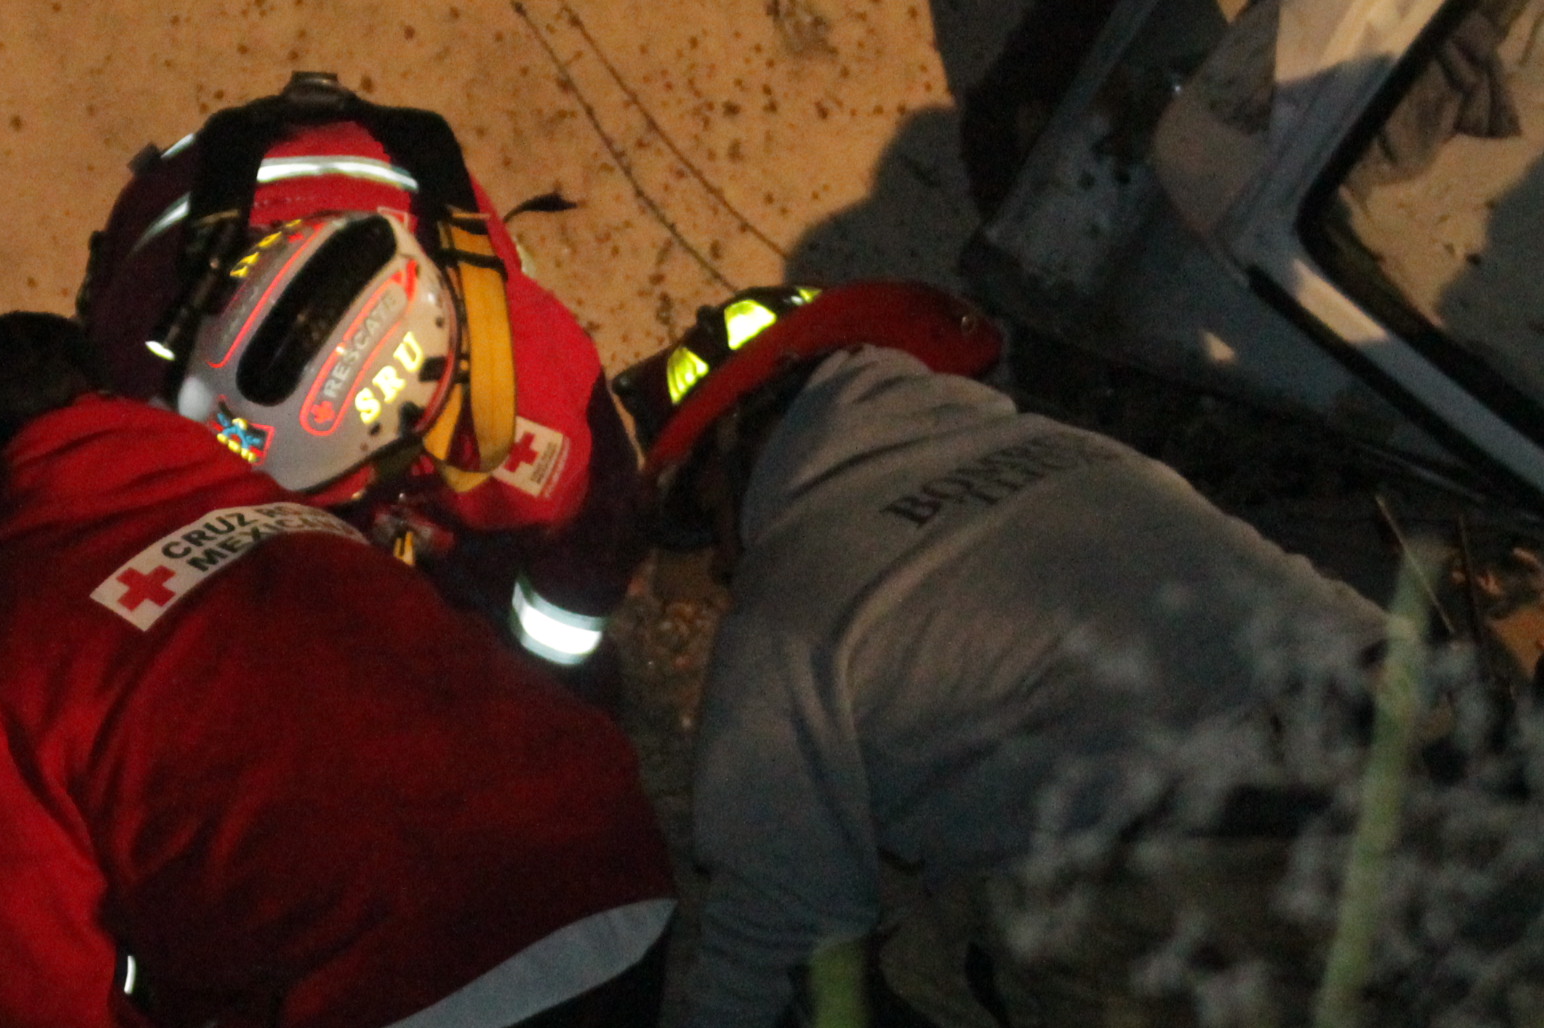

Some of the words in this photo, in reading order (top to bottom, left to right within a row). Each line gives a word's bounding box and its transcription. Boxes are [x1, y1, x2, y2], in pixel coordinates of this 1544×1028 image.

[354, 330, 424, 425] SRU
[162, 511, 259, 559] CRUZ
[187, 517, 353, 572] MEXICA
